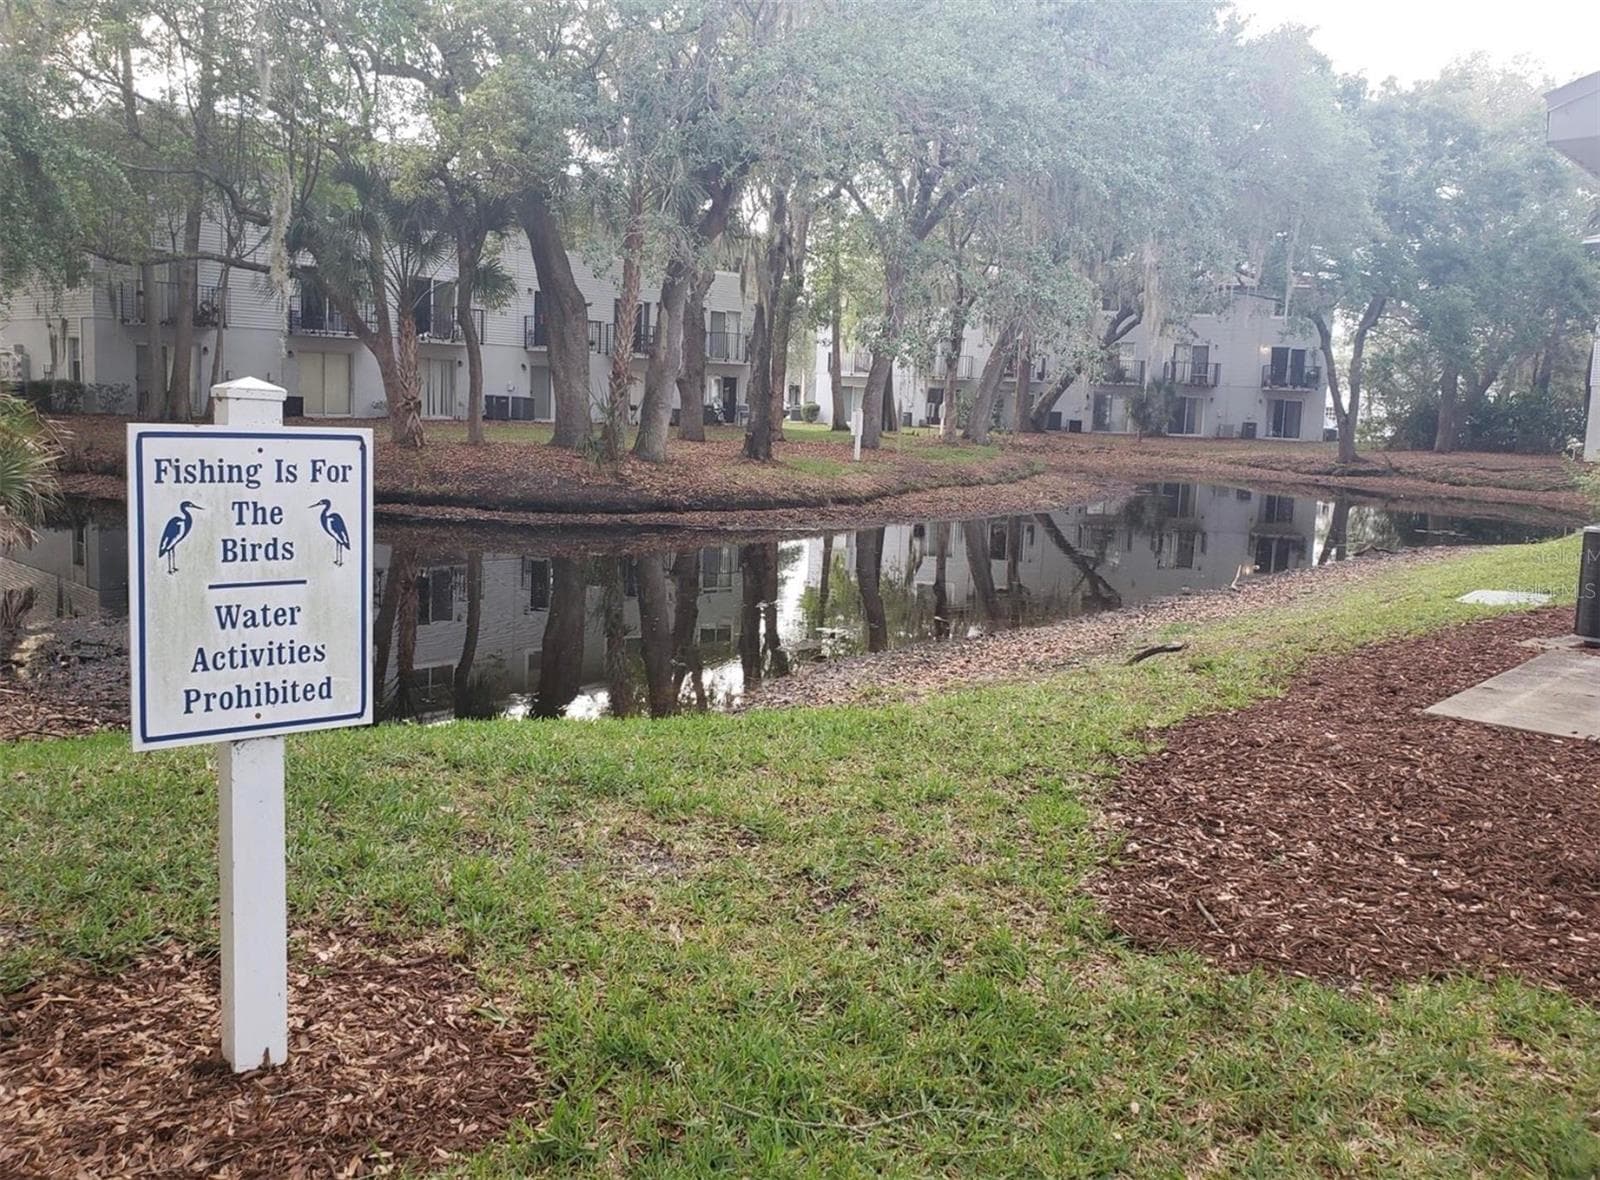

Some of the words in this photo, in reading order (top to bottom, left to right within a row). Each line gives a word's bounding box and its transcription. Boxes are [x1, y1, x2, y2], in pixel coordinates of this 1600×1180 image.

[154, 458, 262, 489] Fishing
[275, 458, 298, 484] Is
[310, 459, 353, 483] For
[231, 501, 284, 526] The
[221, 538, 294, 563] Birds
[214, 604, 302, 630] Water
[190, 639, 326, 673] Activities
[183, 676, 333, 715] Prohibited
